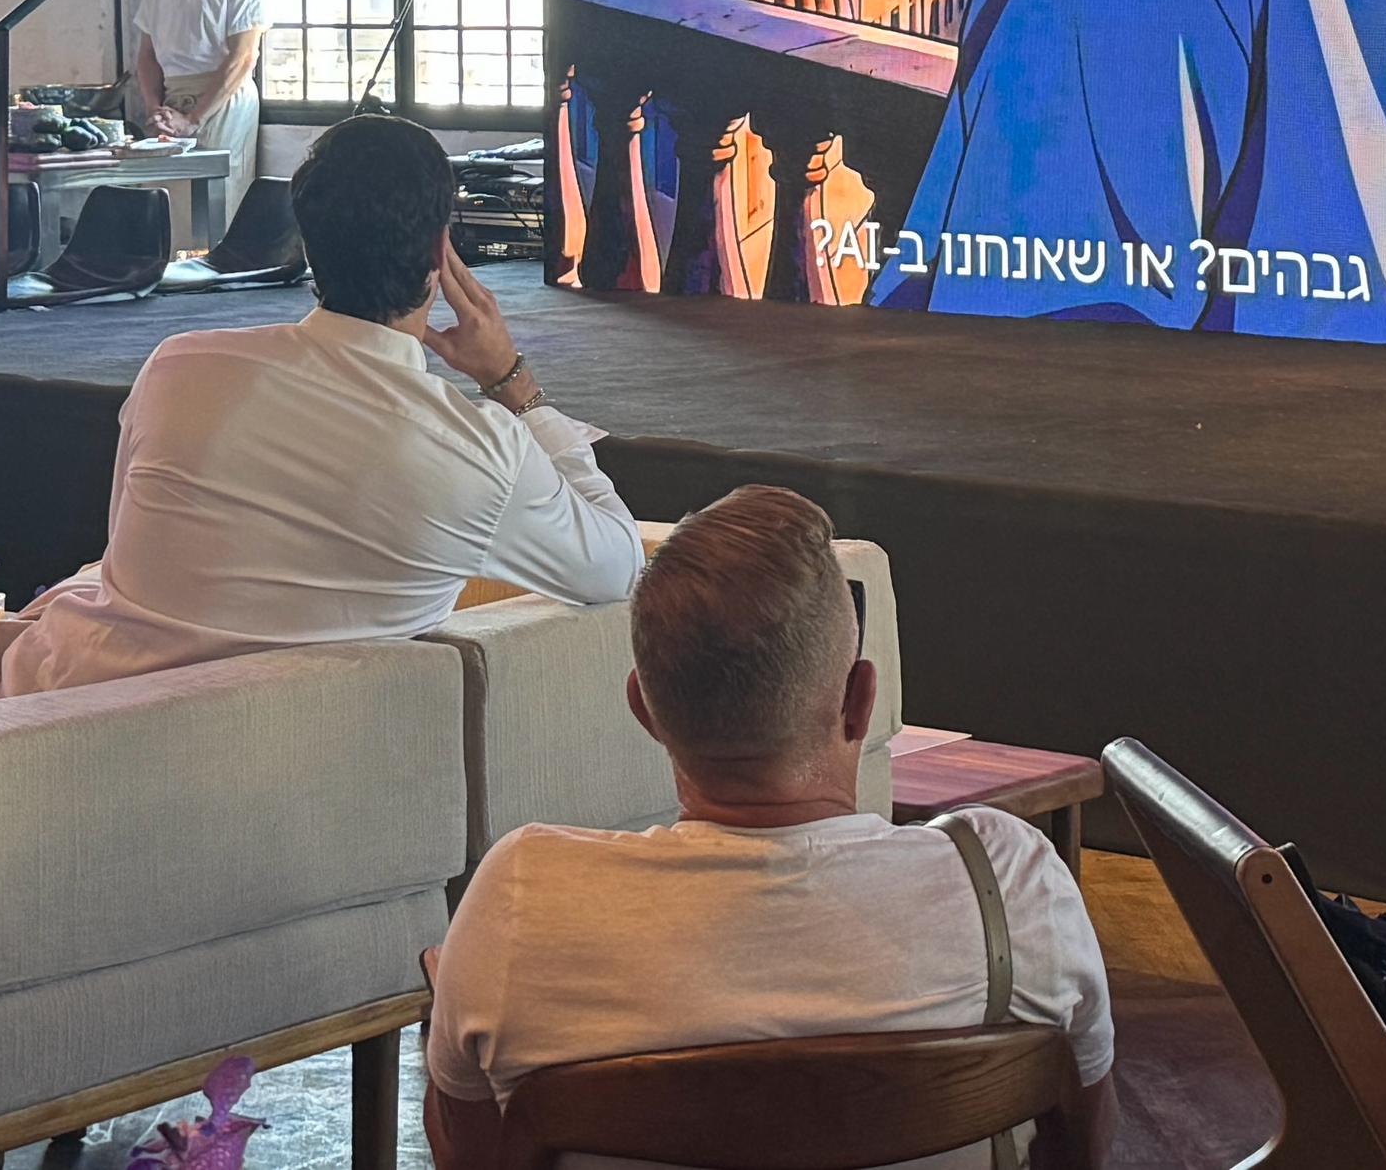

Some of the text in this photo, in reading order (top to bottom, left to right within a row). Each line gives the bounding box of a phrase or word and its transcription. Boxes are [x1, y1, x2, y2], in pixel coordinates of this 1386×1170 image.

[941, 231, 1106, 284] שאנחנו
[1122, 241, 1175, 290] או
[1189, 238, 1371, 302] גבהים?
